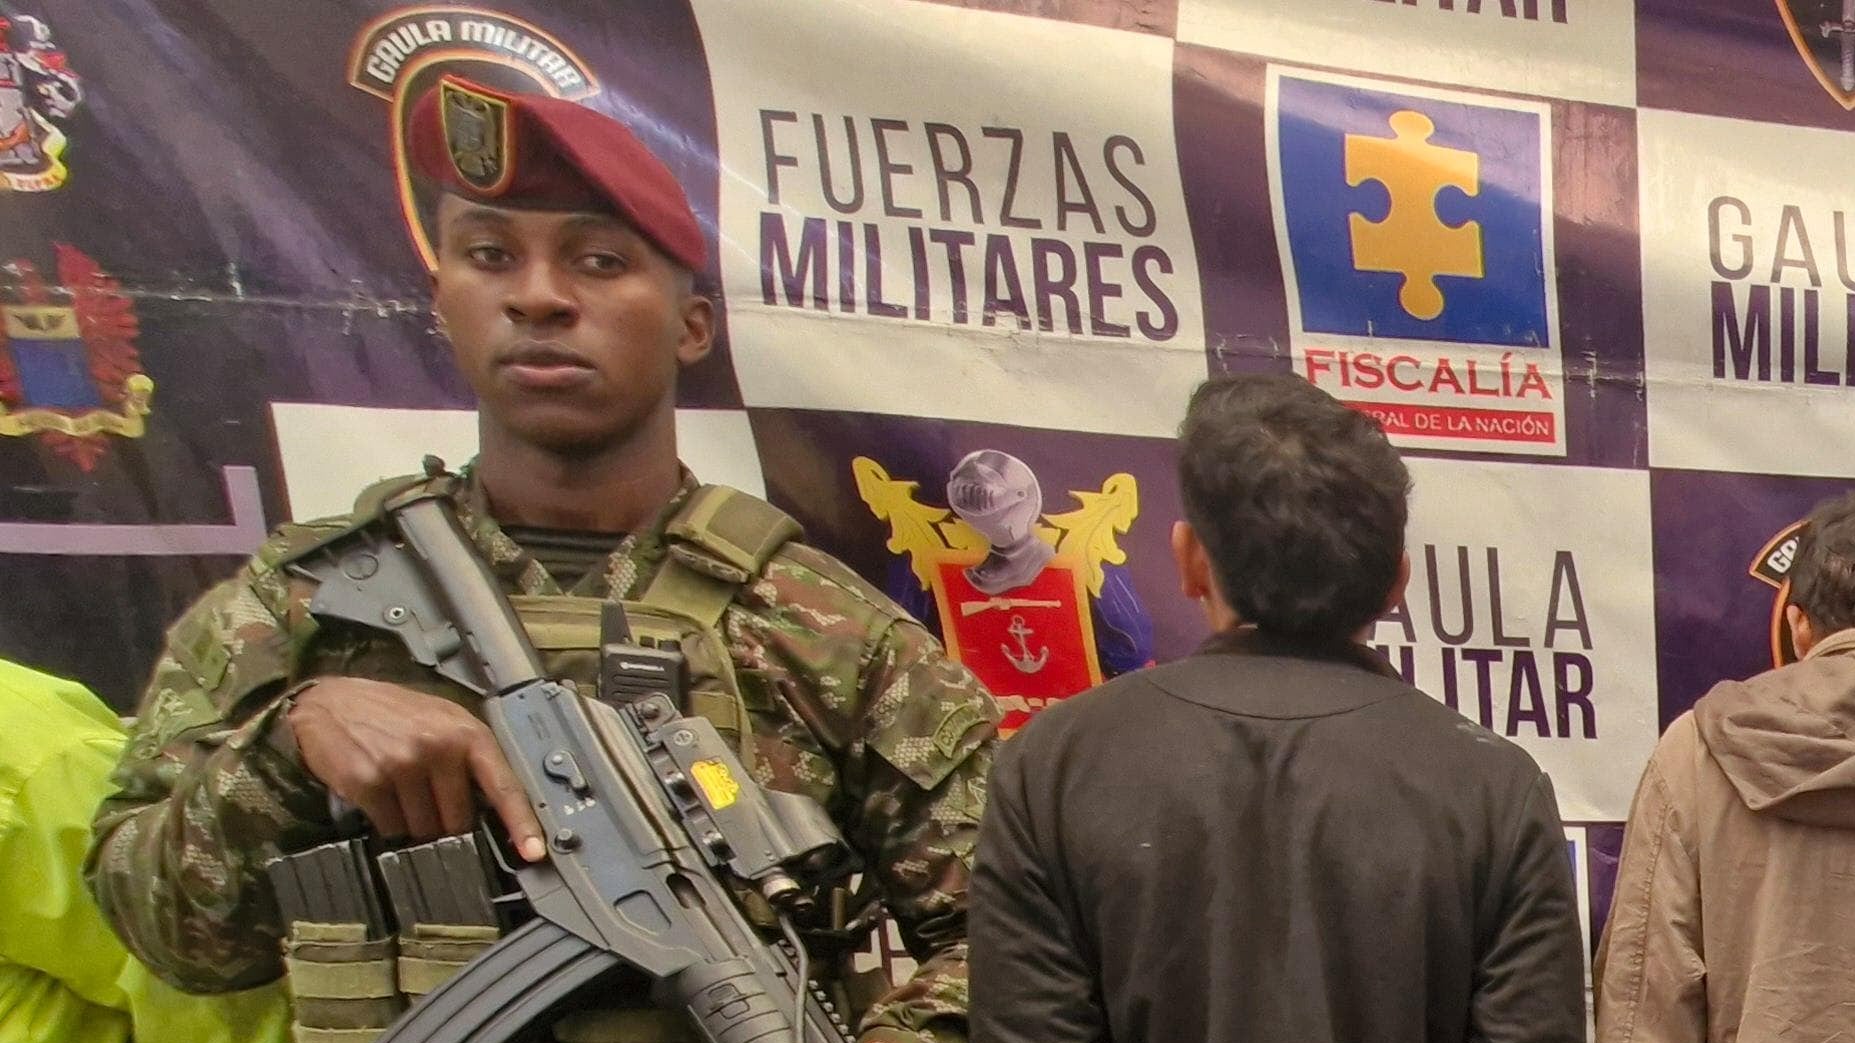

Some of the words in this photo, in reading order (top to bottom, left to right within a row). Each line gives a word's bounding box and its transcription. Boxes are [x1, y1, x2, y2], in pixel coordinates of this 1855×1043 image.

[366, 20, 452, 84] GAULA
[461, 21, 582, 88] MILITAR
[759, 109, 1157, 238] FUERZAS
[760, 212, 1178, 341] MILITARES
[1304, 351, 1553, 400] FISCALÍA
[1415, 413, 1442, 430] DE
[1447, 415, 1473, 431] LA
[1475, 415, 1549, 436] NACIÓN
